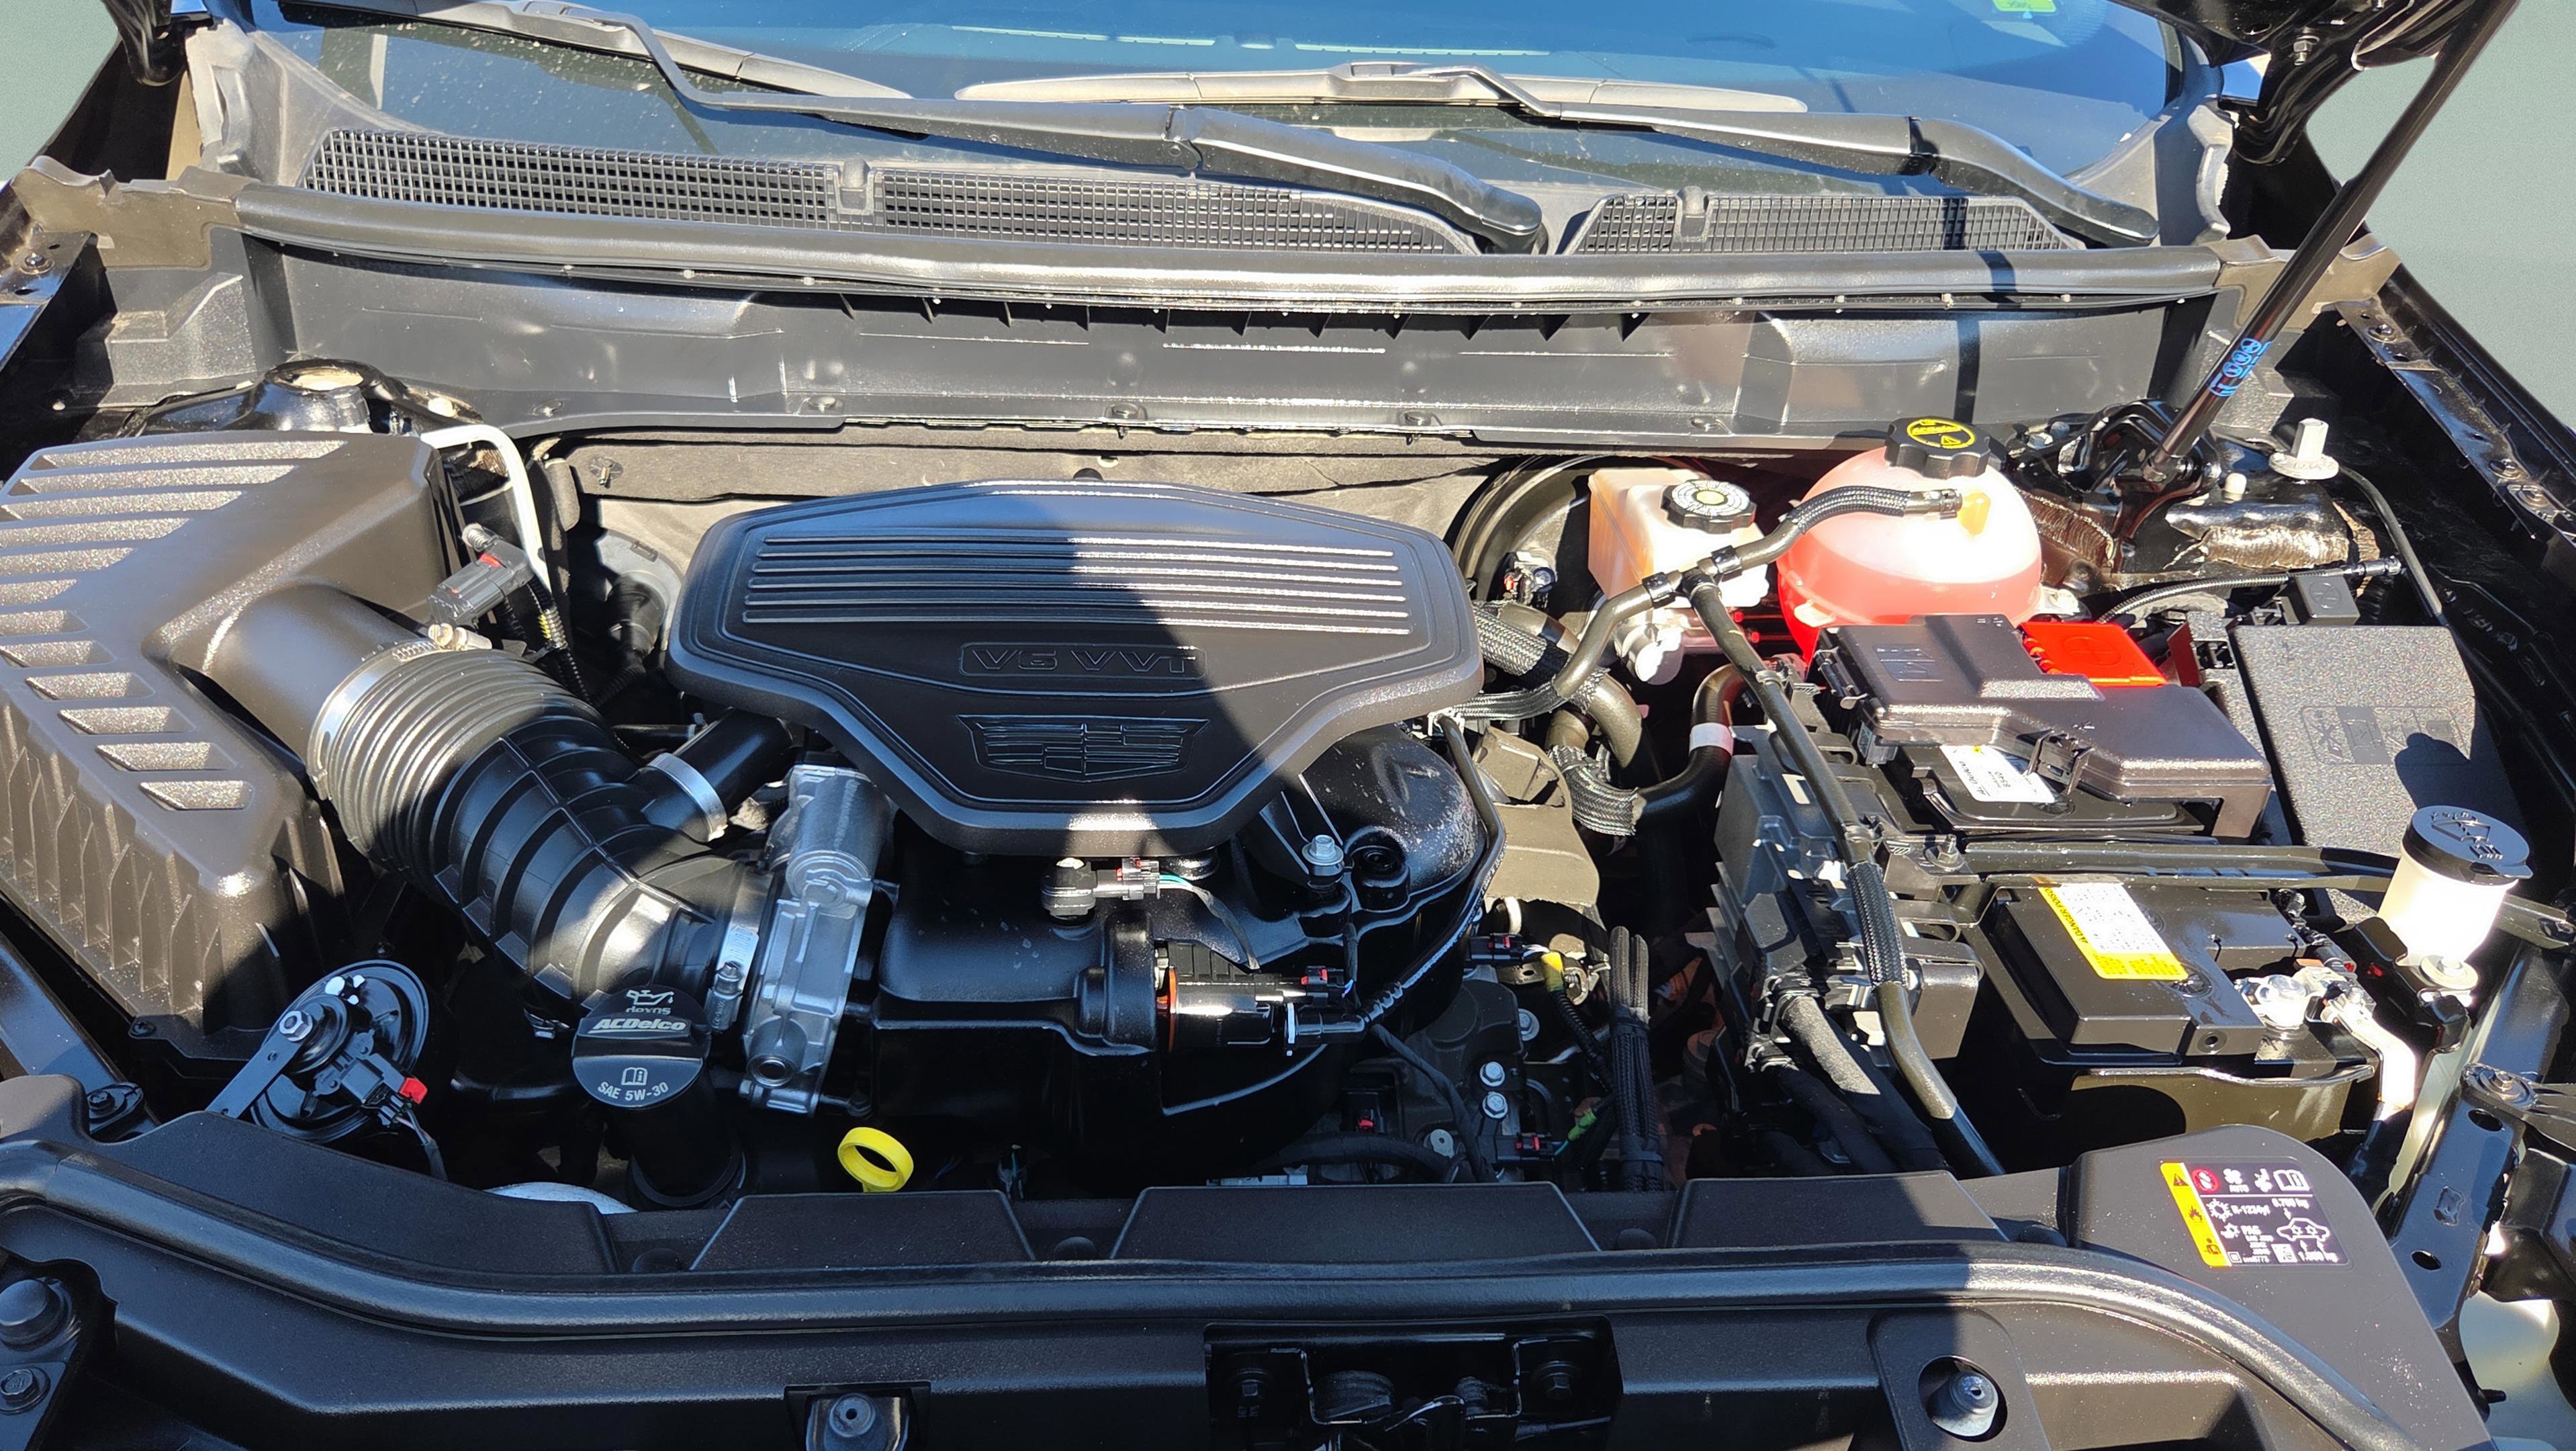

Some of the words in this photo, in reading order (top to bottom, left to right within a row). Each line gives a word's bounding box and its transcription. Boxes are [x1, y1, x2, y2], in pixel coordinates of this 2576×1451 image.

[972, 649, 1058, 670] V6
[1070, 650, 1196, 673] VVT
[592, 1018, 686, 1030] ACDelco
[598, 1081, 621, 1100] SAE
[625, 1081, 669, 1102] 5W-30
